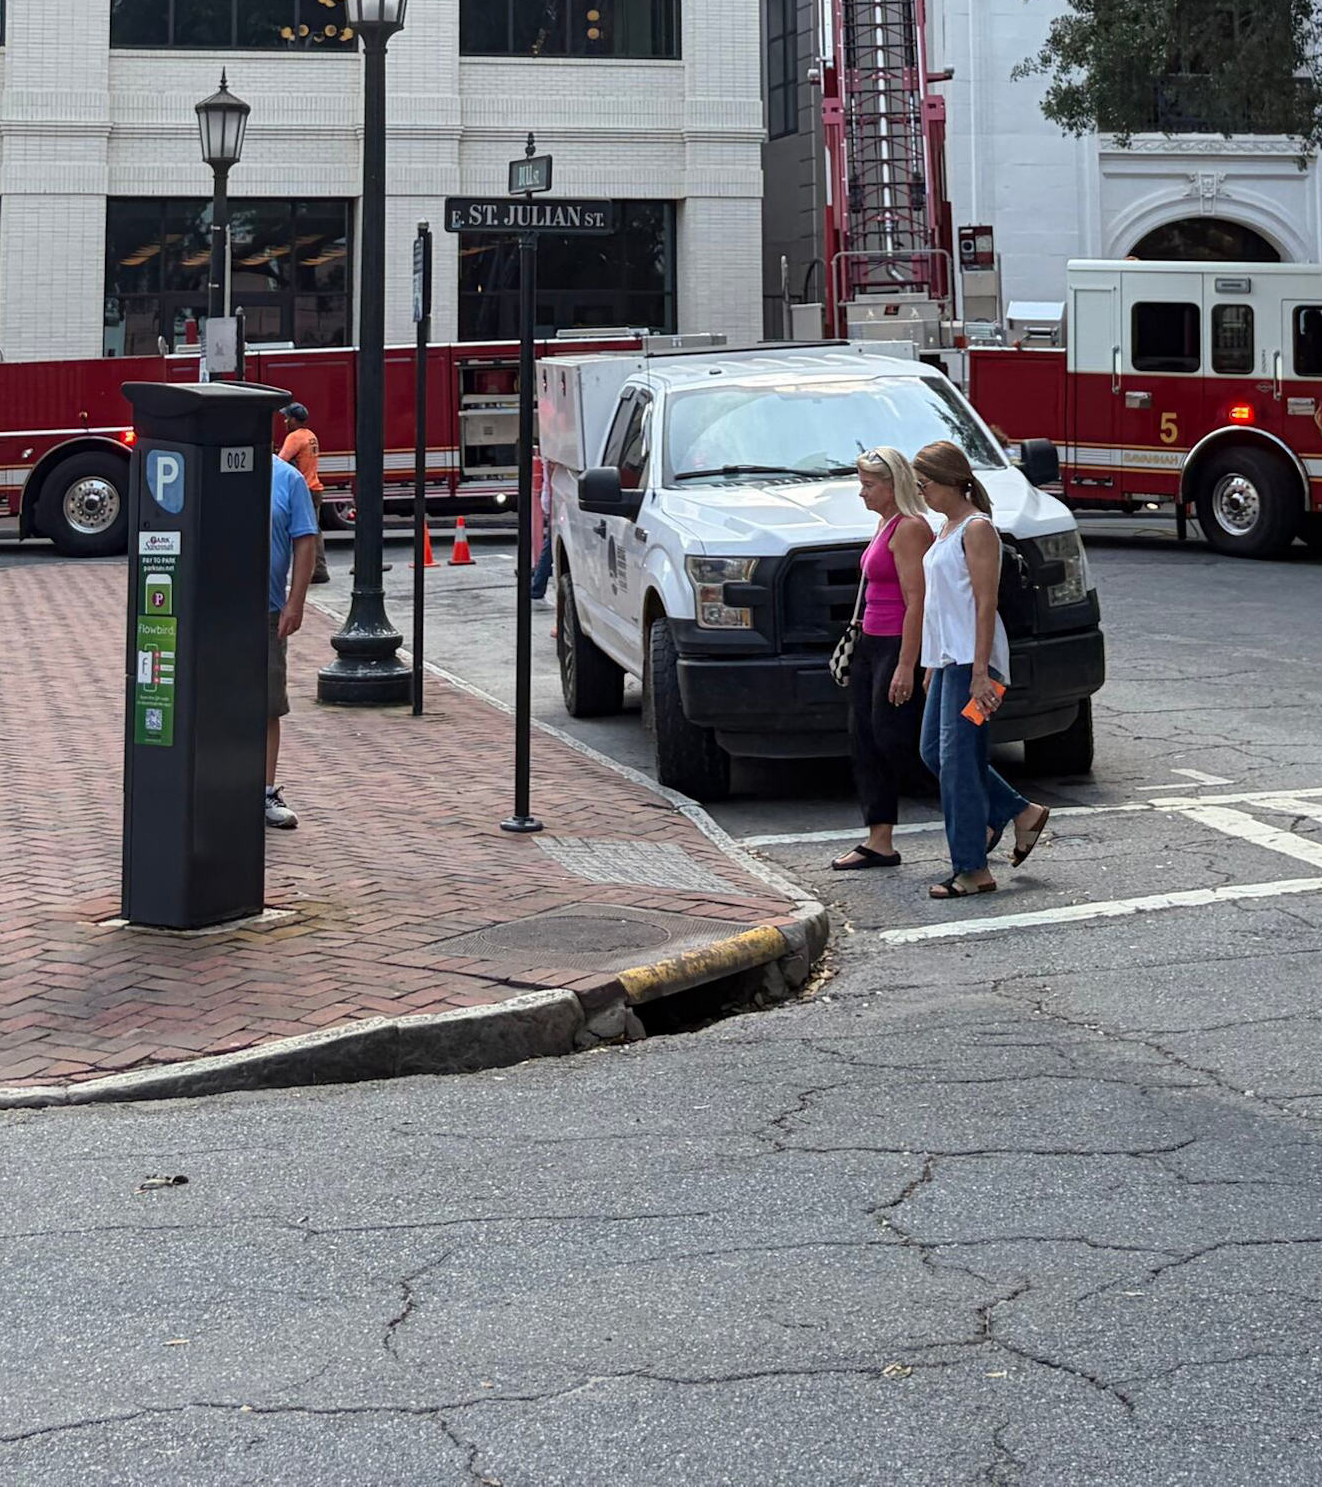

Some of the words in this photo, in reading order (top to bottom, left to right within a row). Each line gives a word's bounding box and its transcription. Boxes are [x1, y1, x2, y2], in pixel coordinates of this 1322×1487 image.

[469, 204, 498, 226] ST.
[503, 204, 582, 227] JULIAN
[584, 212, 605, 227] ST.
[1159, 412, 1178, 444] 5
[227, 451, 247, 469] 002
[156, 456, 179, 502] P
